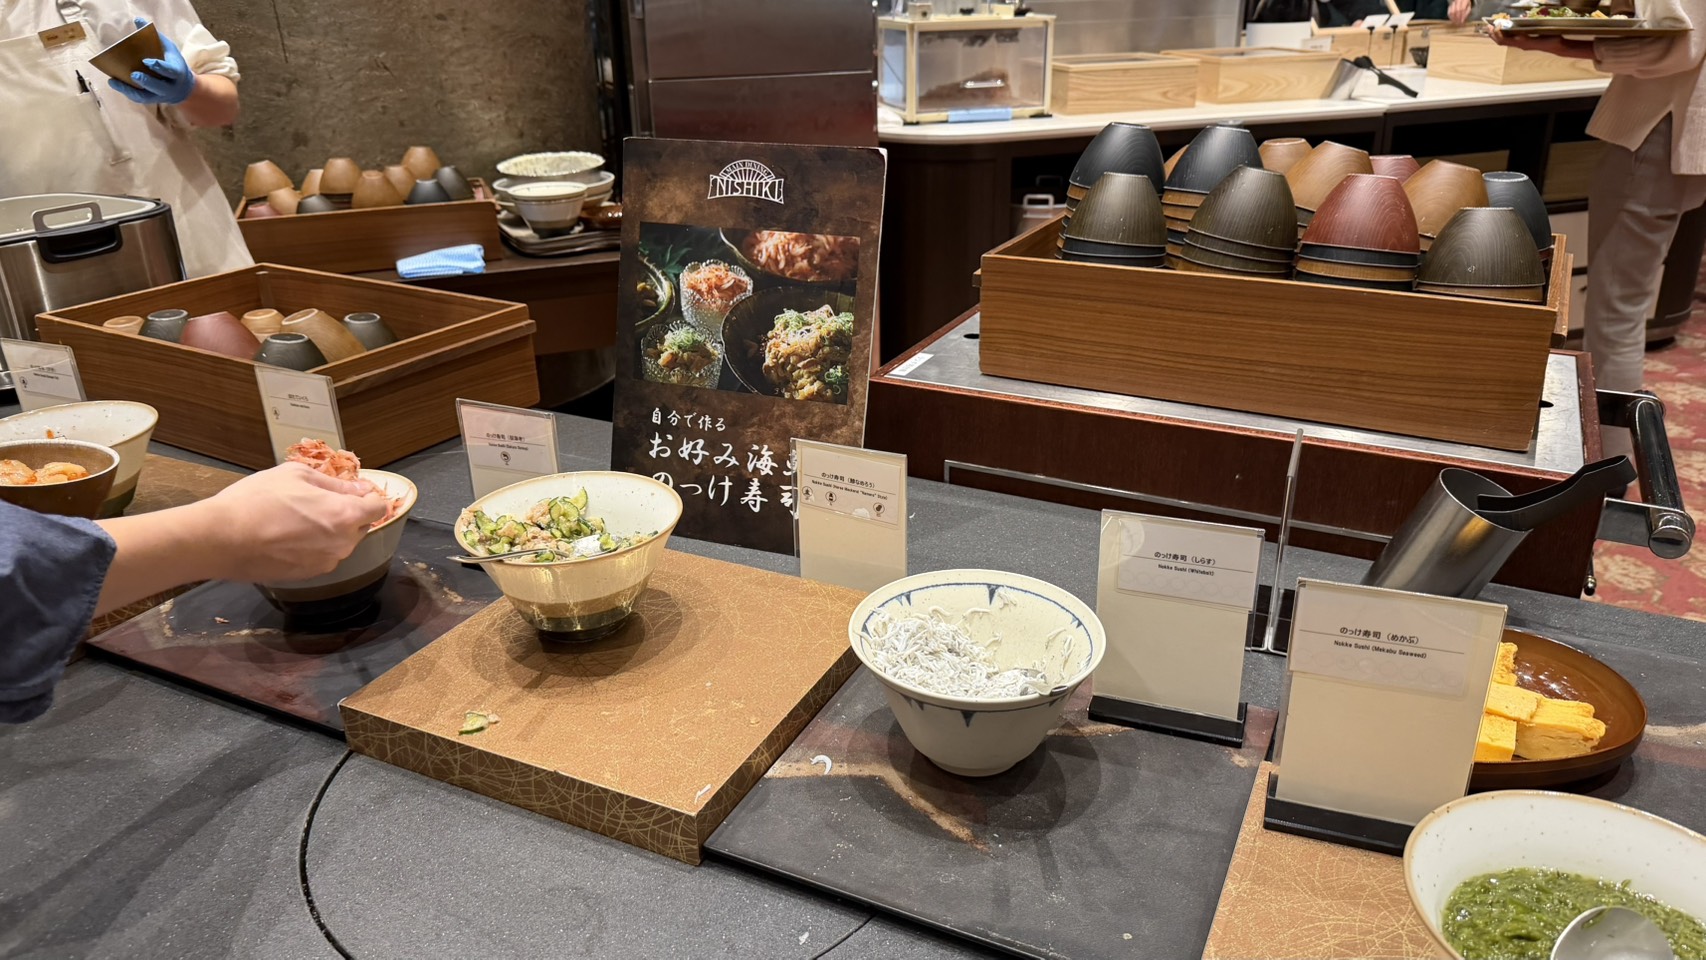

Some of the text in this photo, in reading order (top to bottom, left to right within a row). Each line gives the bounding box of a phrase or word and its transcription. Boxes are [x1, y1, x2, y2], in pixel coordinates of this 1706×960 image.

[707, 174, 784, 204] NISHIKI
[651, 407, 726, 432] 自分で作る
[1334, 640, 1353, 648] Nokke
[1354, 642, 1370, 651] Sushi
